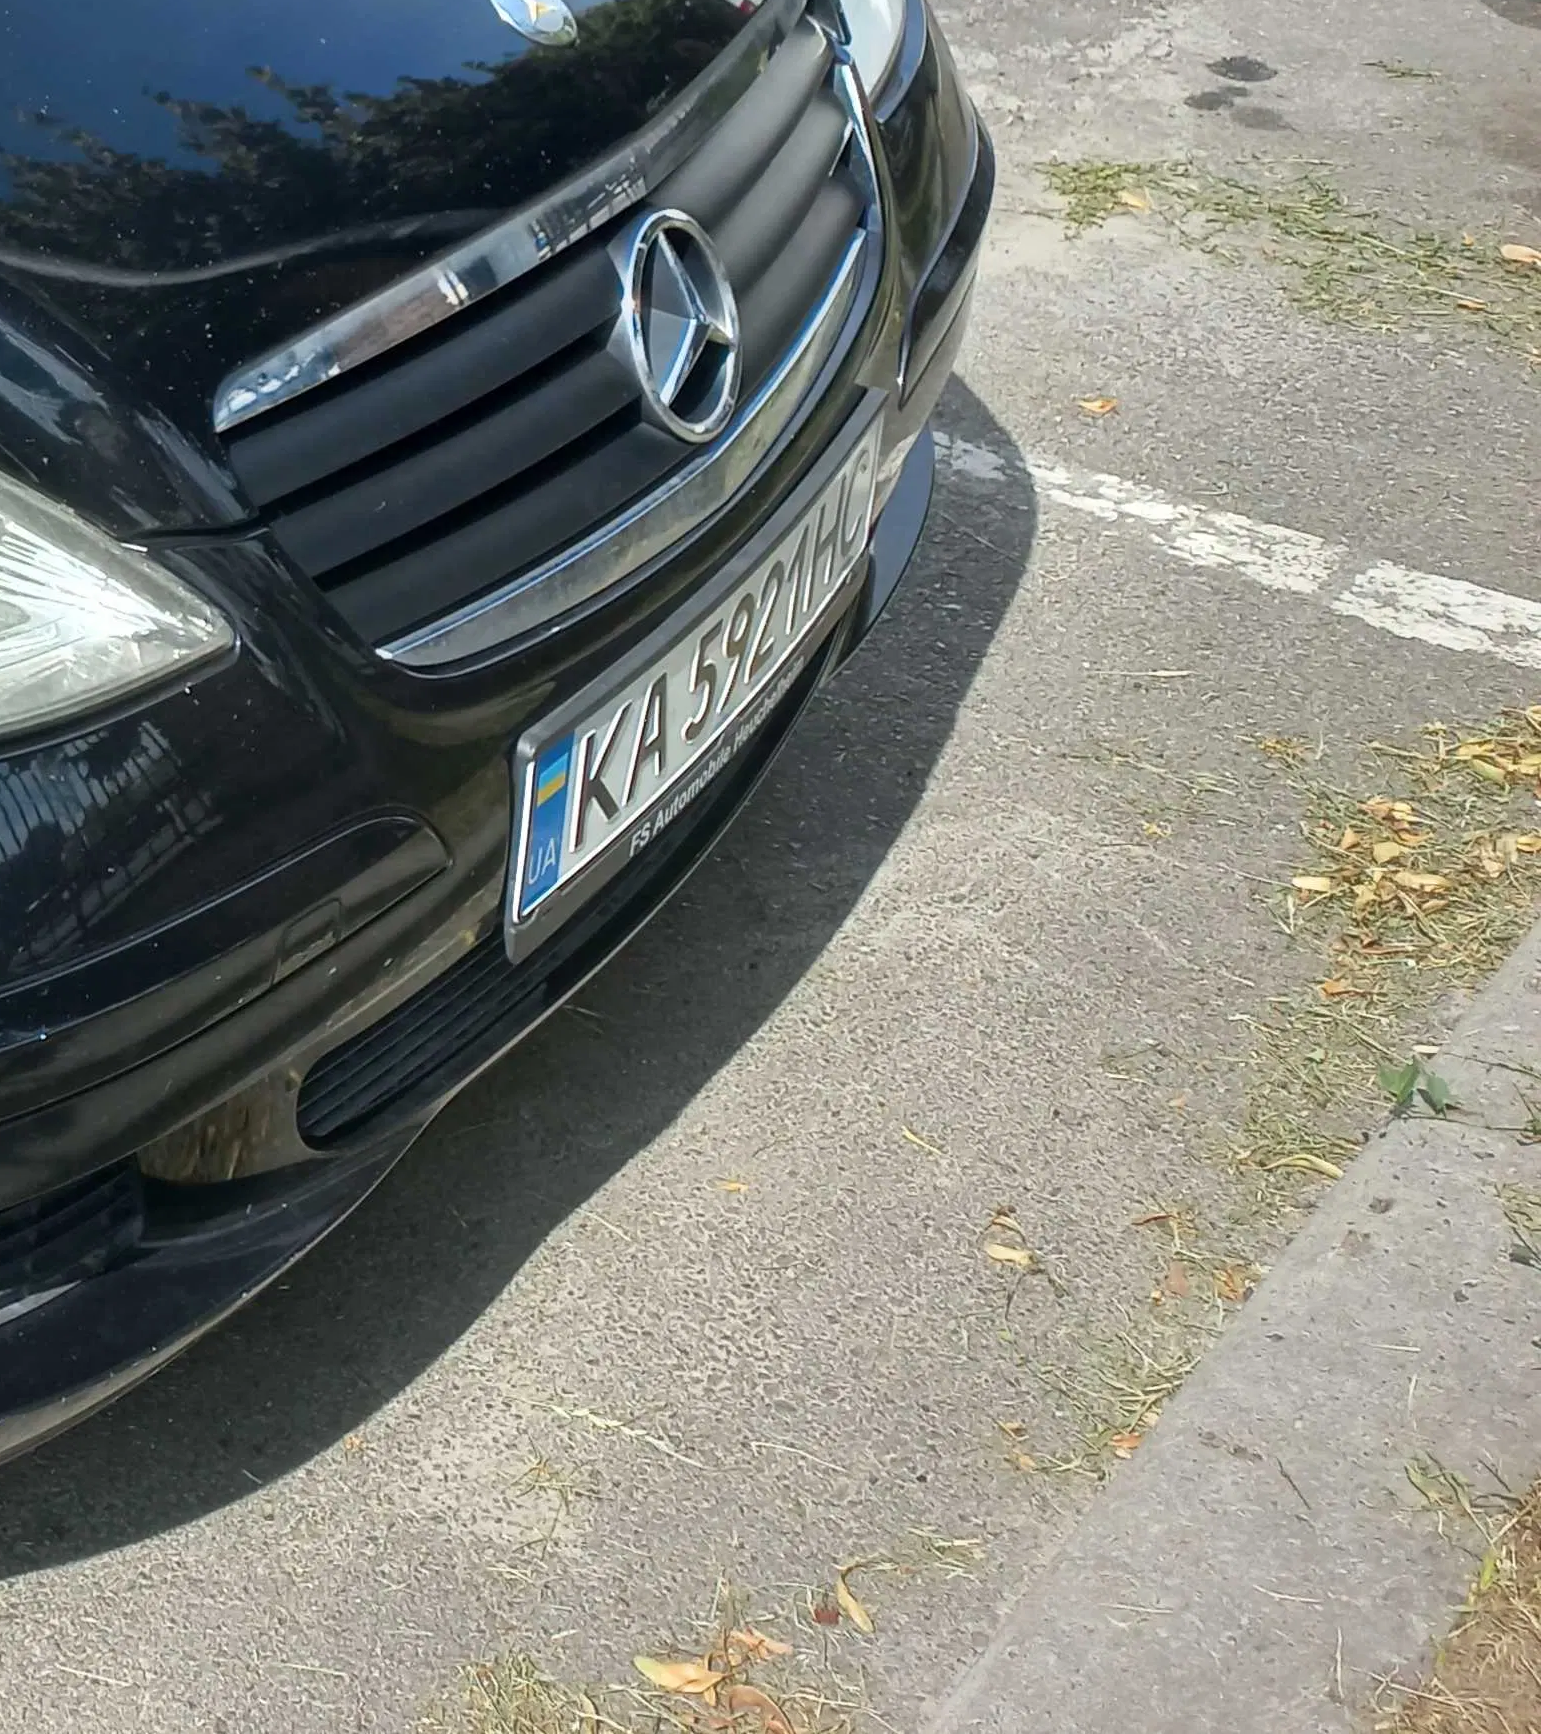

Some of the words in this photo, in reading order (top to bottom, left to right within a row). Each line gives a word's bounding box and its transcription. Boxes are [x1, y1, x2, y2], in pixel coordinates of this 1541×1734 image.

[569, 671, 668, 855] KA
[629, 821, 652, 858] FS
[652, 732, 732, 837] Automobile
[528, 836, 557, 886] UA
